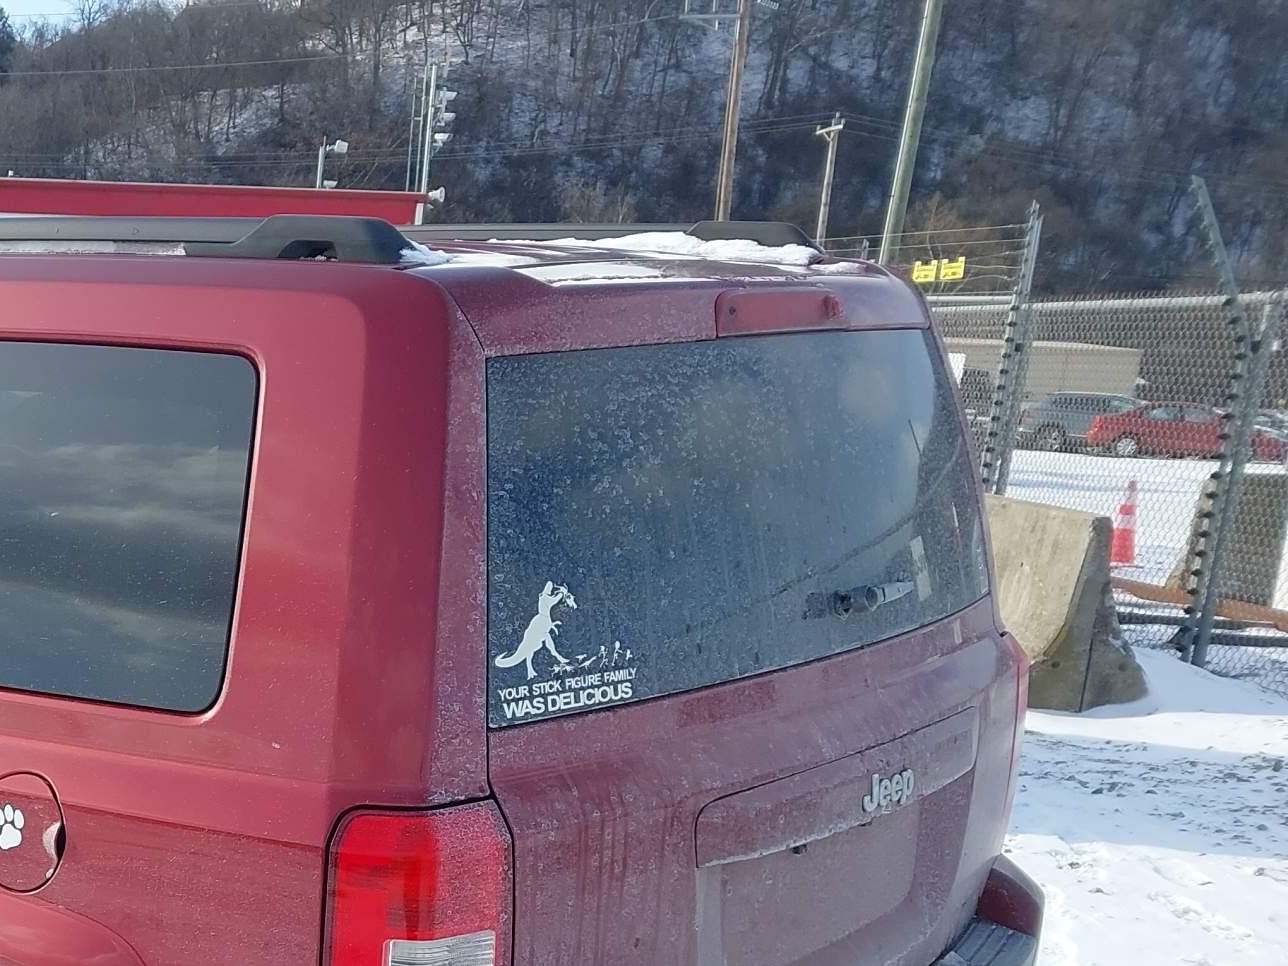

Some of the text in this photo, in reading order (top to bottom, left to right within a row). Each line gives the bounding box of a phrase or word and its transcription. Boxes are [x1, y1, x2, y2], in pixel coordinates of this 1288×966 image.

[498, 667, 638, 702] YOUR STICK FIGURE FAMILY
[502, 682, 633, 719] WAS DELICIOUS
[862, 768, 914, 812] Jeep
